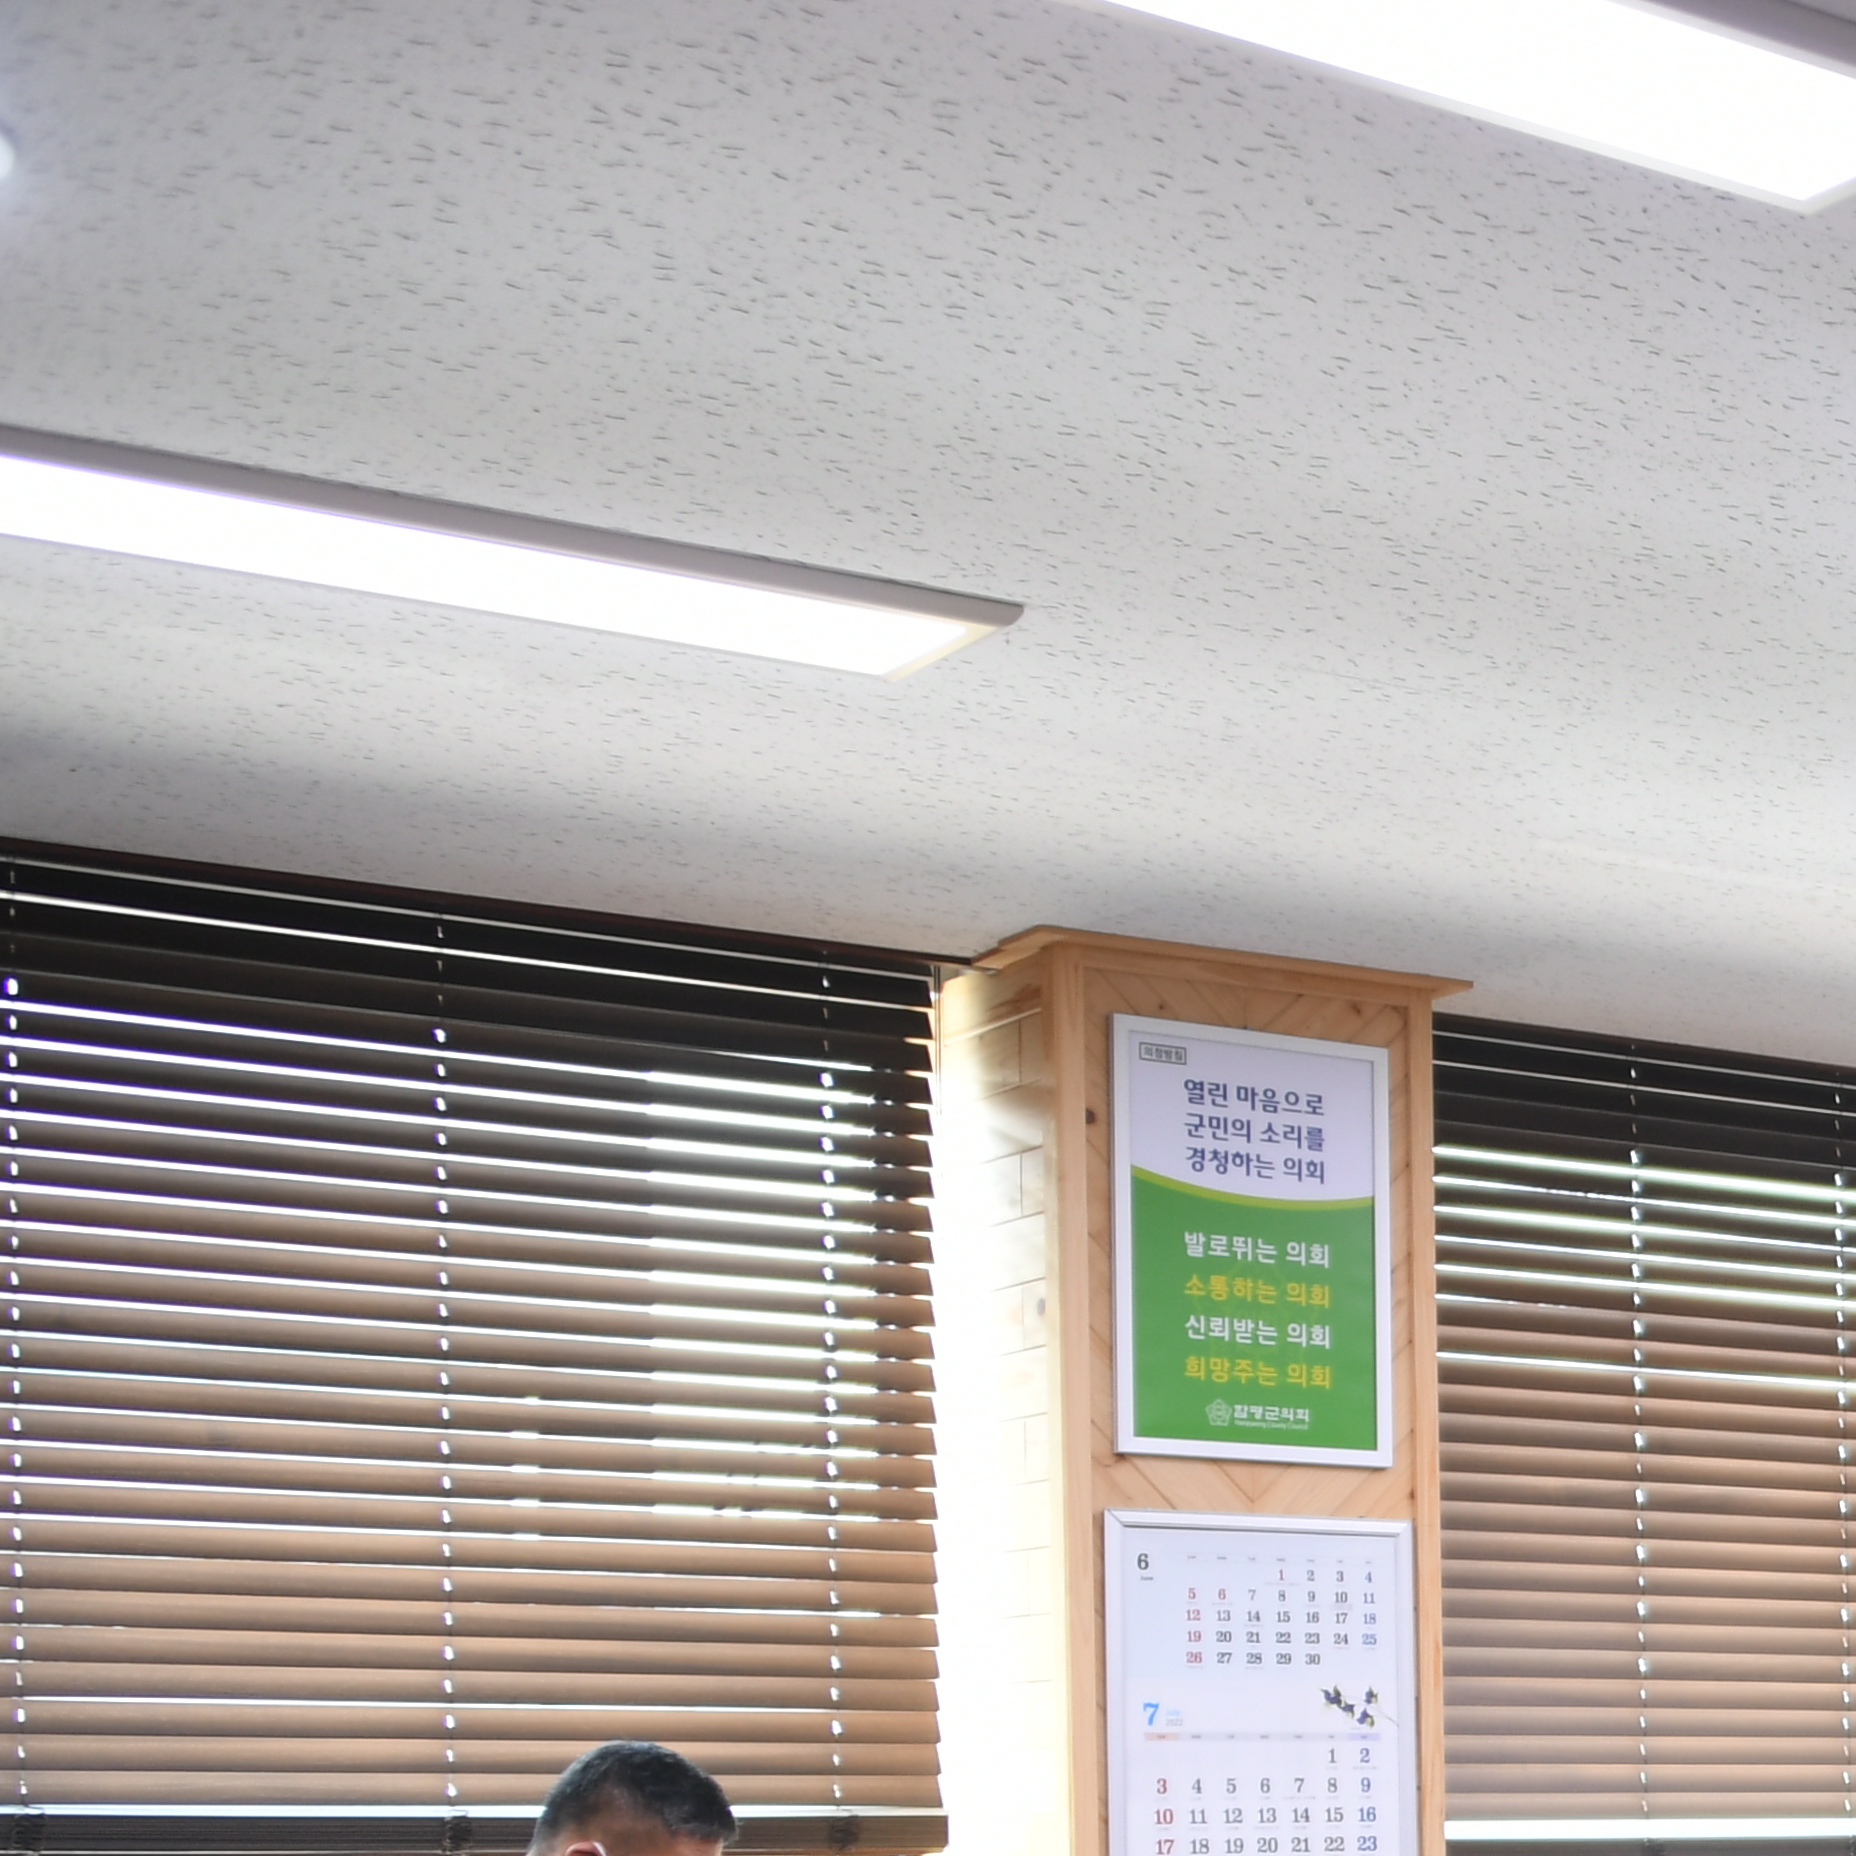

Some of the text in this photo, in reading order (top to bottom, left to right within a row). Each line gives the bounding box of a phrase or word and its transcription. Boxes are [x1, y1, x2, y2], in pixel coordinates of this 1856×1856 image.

[1183, 1078, 1325, 1116] 열린 마음으로
[1184, 1112, 1325, 1152] 군민의 소리를
[1185, 1146, 1325, 1185] 경청하는 의회
[1184, 1230, 1330, 1269] 발로뛰는 의회
[1184, 1273, 1330, 1309] 소통하는 의회
[1185, 1314, 1331, 1350] 신뢰받는 의회
[1184, 1355, 1331, 1390] 희망주는 의회
[1233, 1403, 1311, 1423] 함평군의회
[1136, 1552, 1150, 1570] 6
[1279, 1568, 1373, 1583] 1 2 3 4
[1187, 1587, 1375, 1604] 5 6 7 8 9 10 11
[1186, 1609, 1376, 1624] 12 13 14 15 16 17 18
[1187, 1631, 1377, 1645] 19 20 21 22 23 24 25
[1187, 1652, 1320, 1665] 26 27 28 29 30
[1142, 1701, 1160, 1725] 7
[1329, 1747, 1371, 1763] 1 2
[1156, 1776, 1372, 1794] 3 4 5 6 7 8 9
[1155, 1807, 1376, 1824] 10 11 12 13 14 15 16
[1156, 1836, 1377, 1855] 17 18 19 20 21 22 23
